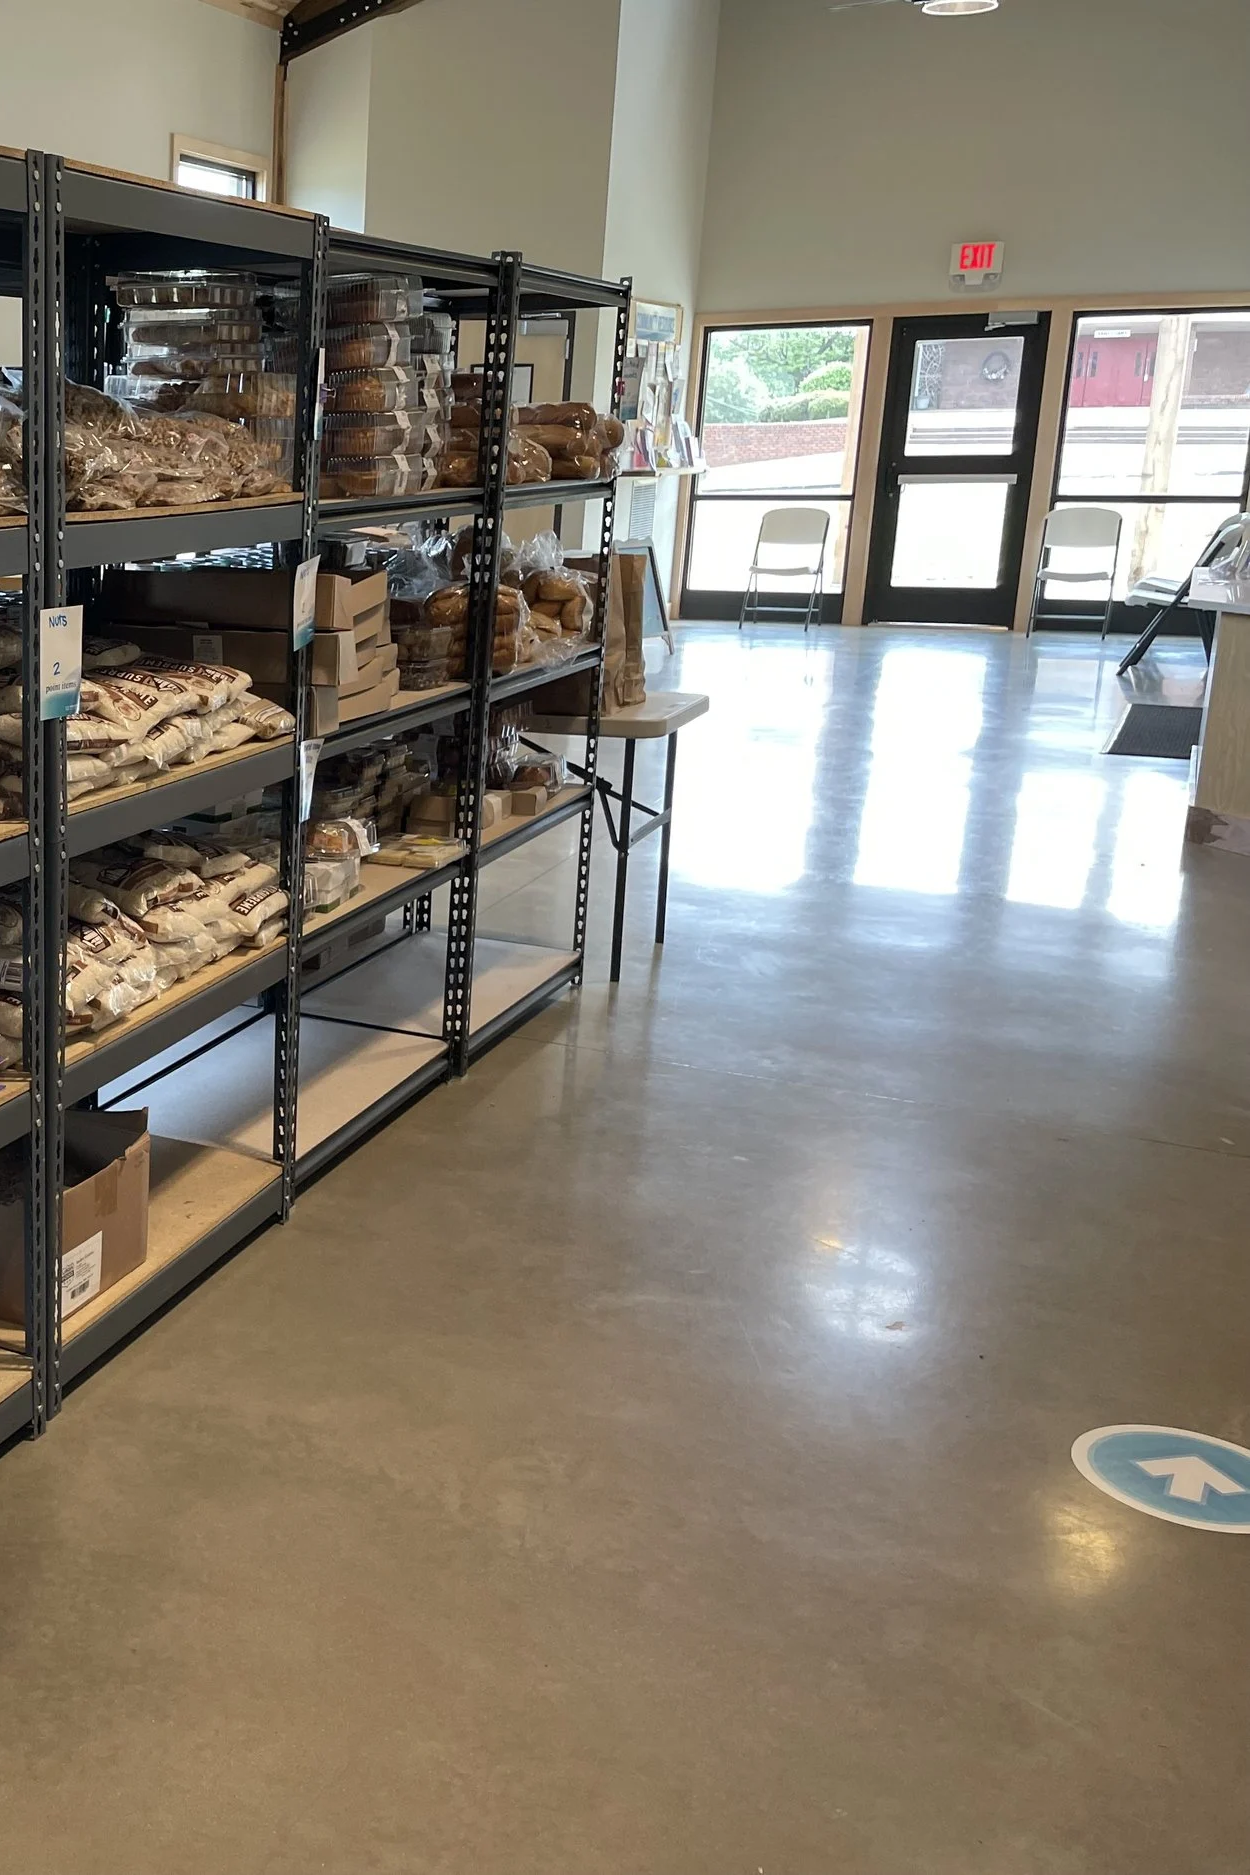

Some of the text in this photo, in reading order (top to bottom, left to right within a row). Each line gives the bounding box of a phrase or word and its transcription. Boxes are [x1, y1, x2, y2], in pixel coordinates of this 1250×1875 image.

[959, 243, 996, 270] EXIT
[53, 662, 61, 676] 2
[46, 683, 60, 694] point
